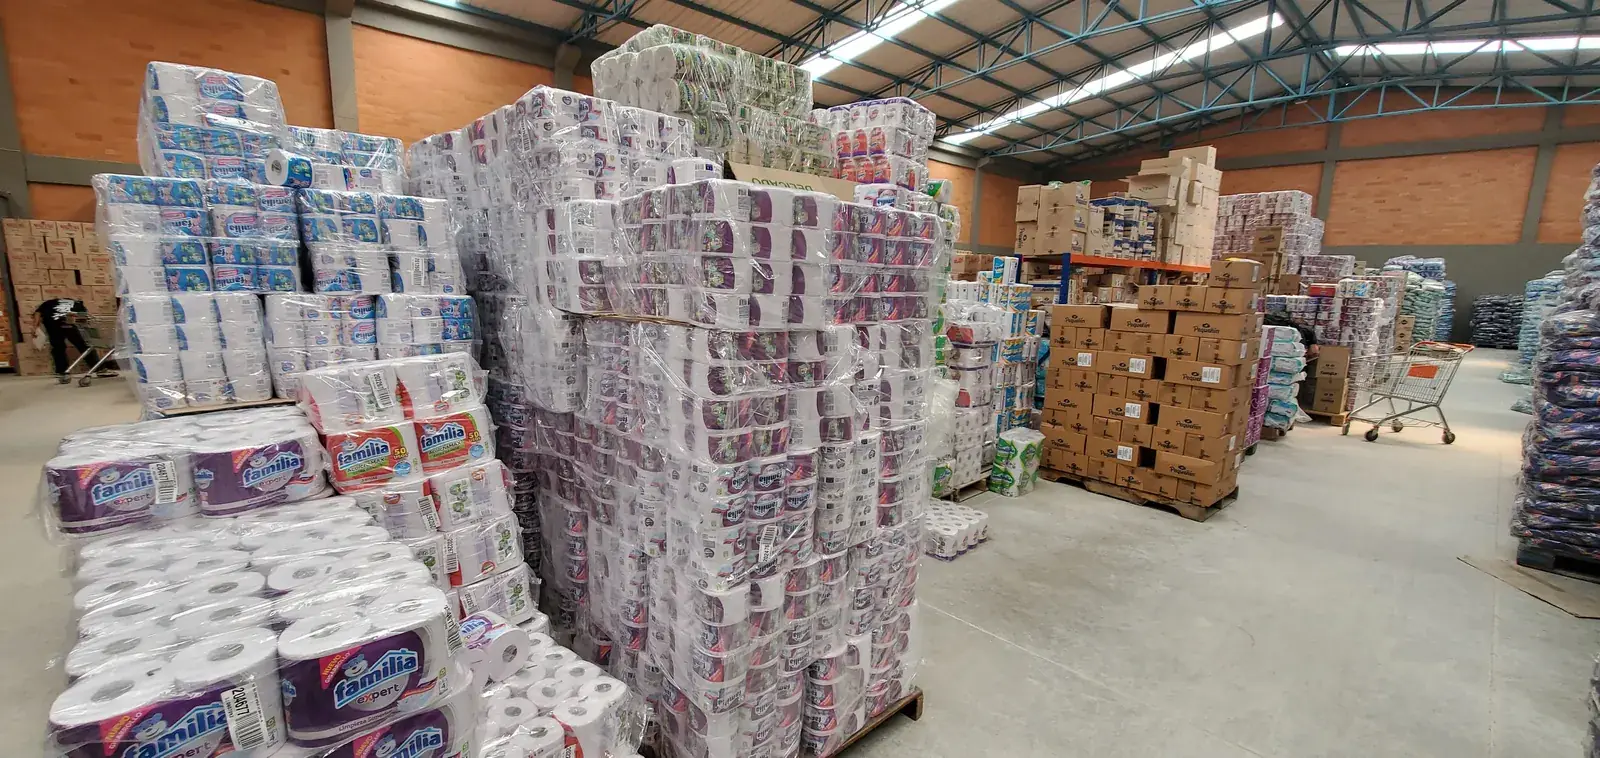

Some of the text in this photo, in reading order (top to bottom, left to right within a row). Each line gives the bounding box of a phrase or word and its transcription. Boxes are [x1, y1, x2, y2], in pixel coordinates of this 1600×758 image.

[421, 427, 464, 447] familia
[468, 431, 479, 440] 50
[337, 442, 389, 465] familia
[394, 447, 406, 456] 50
[244, 457, 300, 483] familia
[93, 472, 156, 501] famili
[113, 493, 151, 507] expert
[323, 654, 342, 677] NUEVO
[335, 654, 417, 702] familia
[231, 686, 250, 717] 204677
[357, 683, 399, 705] expert
[390, 733, 441, 758] milia
